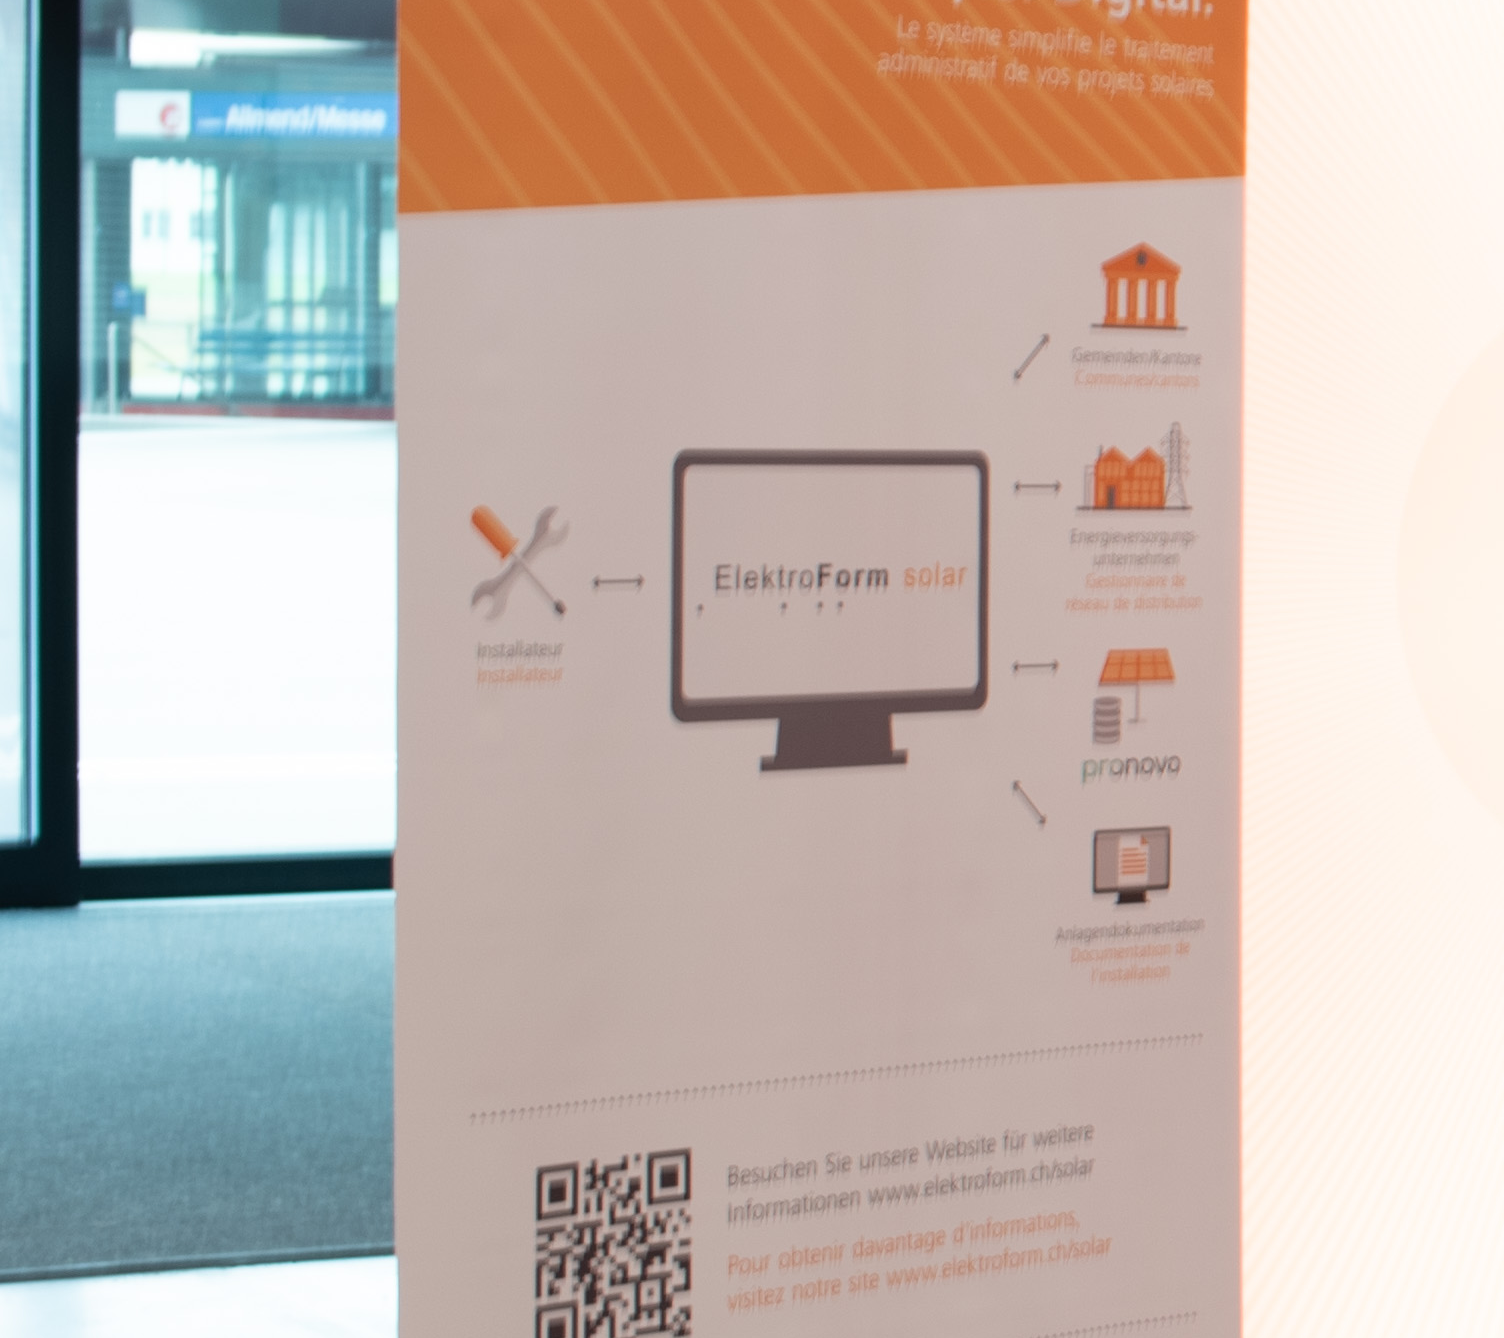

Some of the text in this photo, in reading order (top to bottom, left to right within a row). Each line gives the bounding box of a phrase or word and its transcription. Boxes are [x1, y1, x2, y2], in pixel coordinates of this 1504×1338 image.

[897, 15, 920, 40] Le
[1098, 32, 1117, 55] le
[1005, 59, 1029, 83] de
[1037, 66, 1070, 87] vos
[1077, 66, 1144, 97] projets
[715, 561, 968, 592] ElektroForm solar
[728, 1158, 818, 1188] Besuchen
[825, 1152, 853, 1177] Sie
[859, 1144, 919, 1172] unsere
[925, 1134, 996, 1163] Website
[1033, 1123, 1095, 1148] weitere
[728, 1187, 860, 1223] Informationen
[728, 1252, 769, 1279] Pour
[778, 1241, 846, 1271] obtenir
[852, 1226, 946, 1260] davantage
[727, 1284, 785, 1314] visitez
[792, 1275, 841, 1302] notre
[848, 1268, 880, 1293] site
